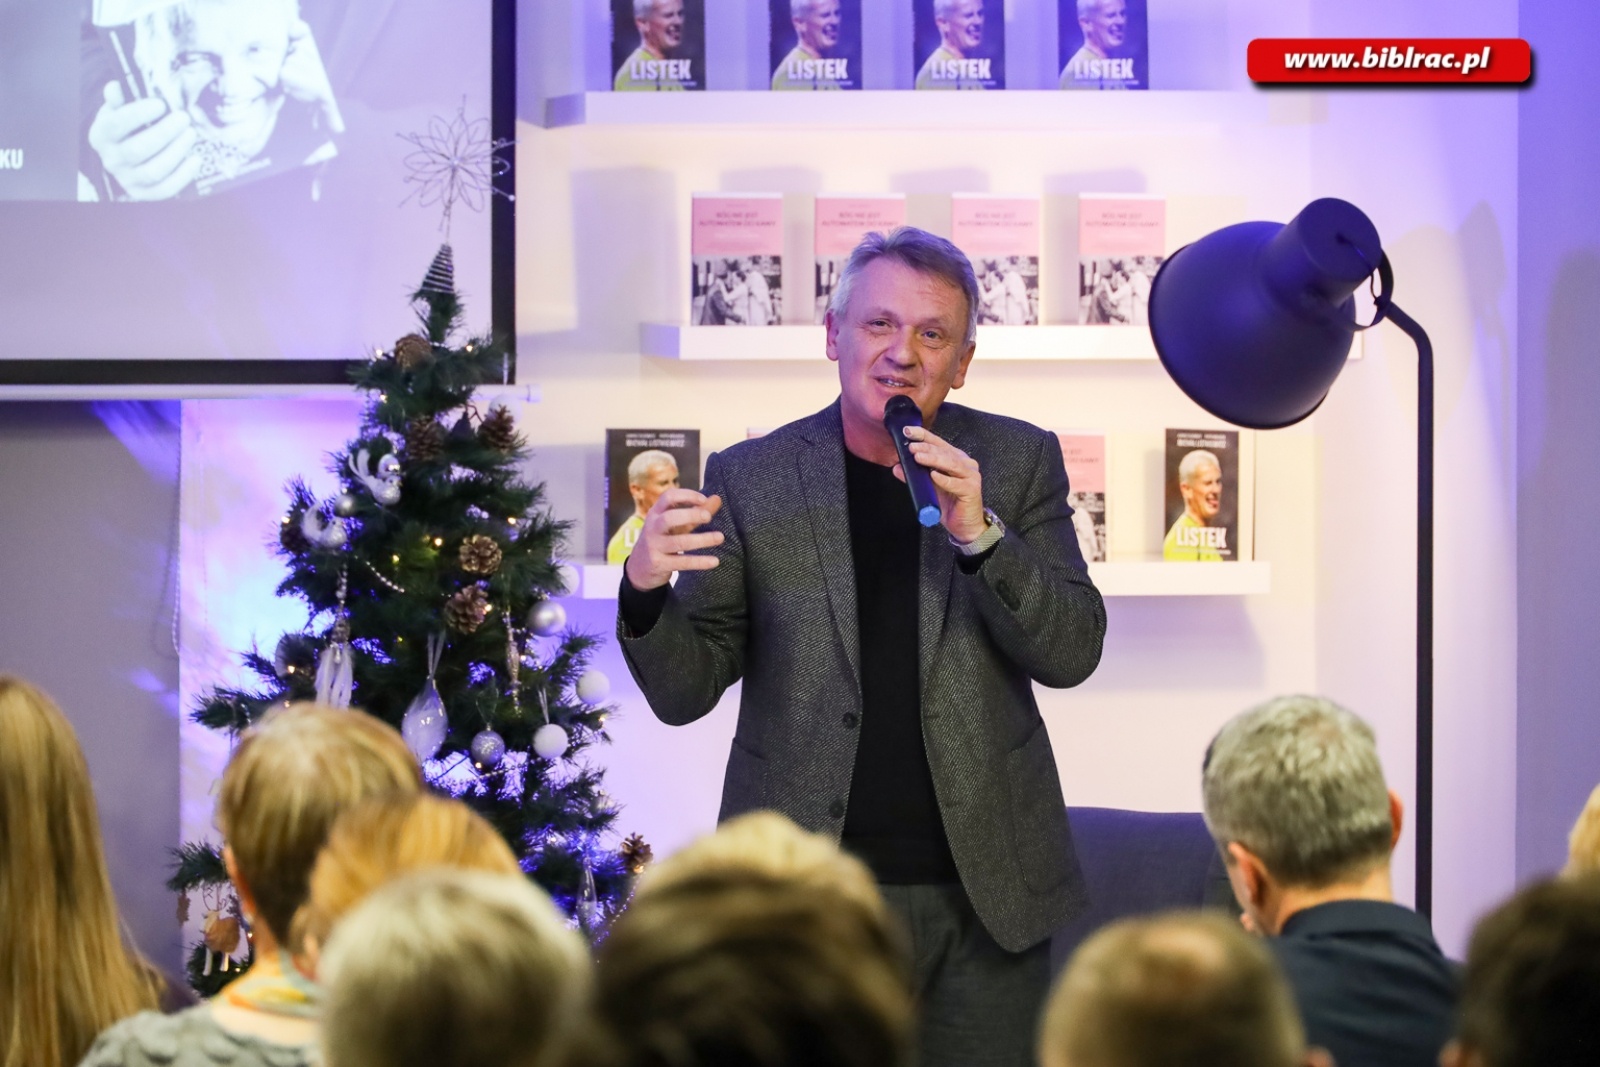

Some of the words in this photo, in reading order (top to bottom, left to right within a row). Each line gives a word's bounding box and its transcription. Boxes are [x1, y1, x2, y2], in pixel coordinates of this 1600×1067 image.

[630, 59, 692, 80] LISTEK
[787, 58, 849, 80] LISTEK
[930, 58, 992, 80] LISTEK
[1073, 58, 1134, 80] LISTEK
[1175, 526, 1228, 549] LISTEK
